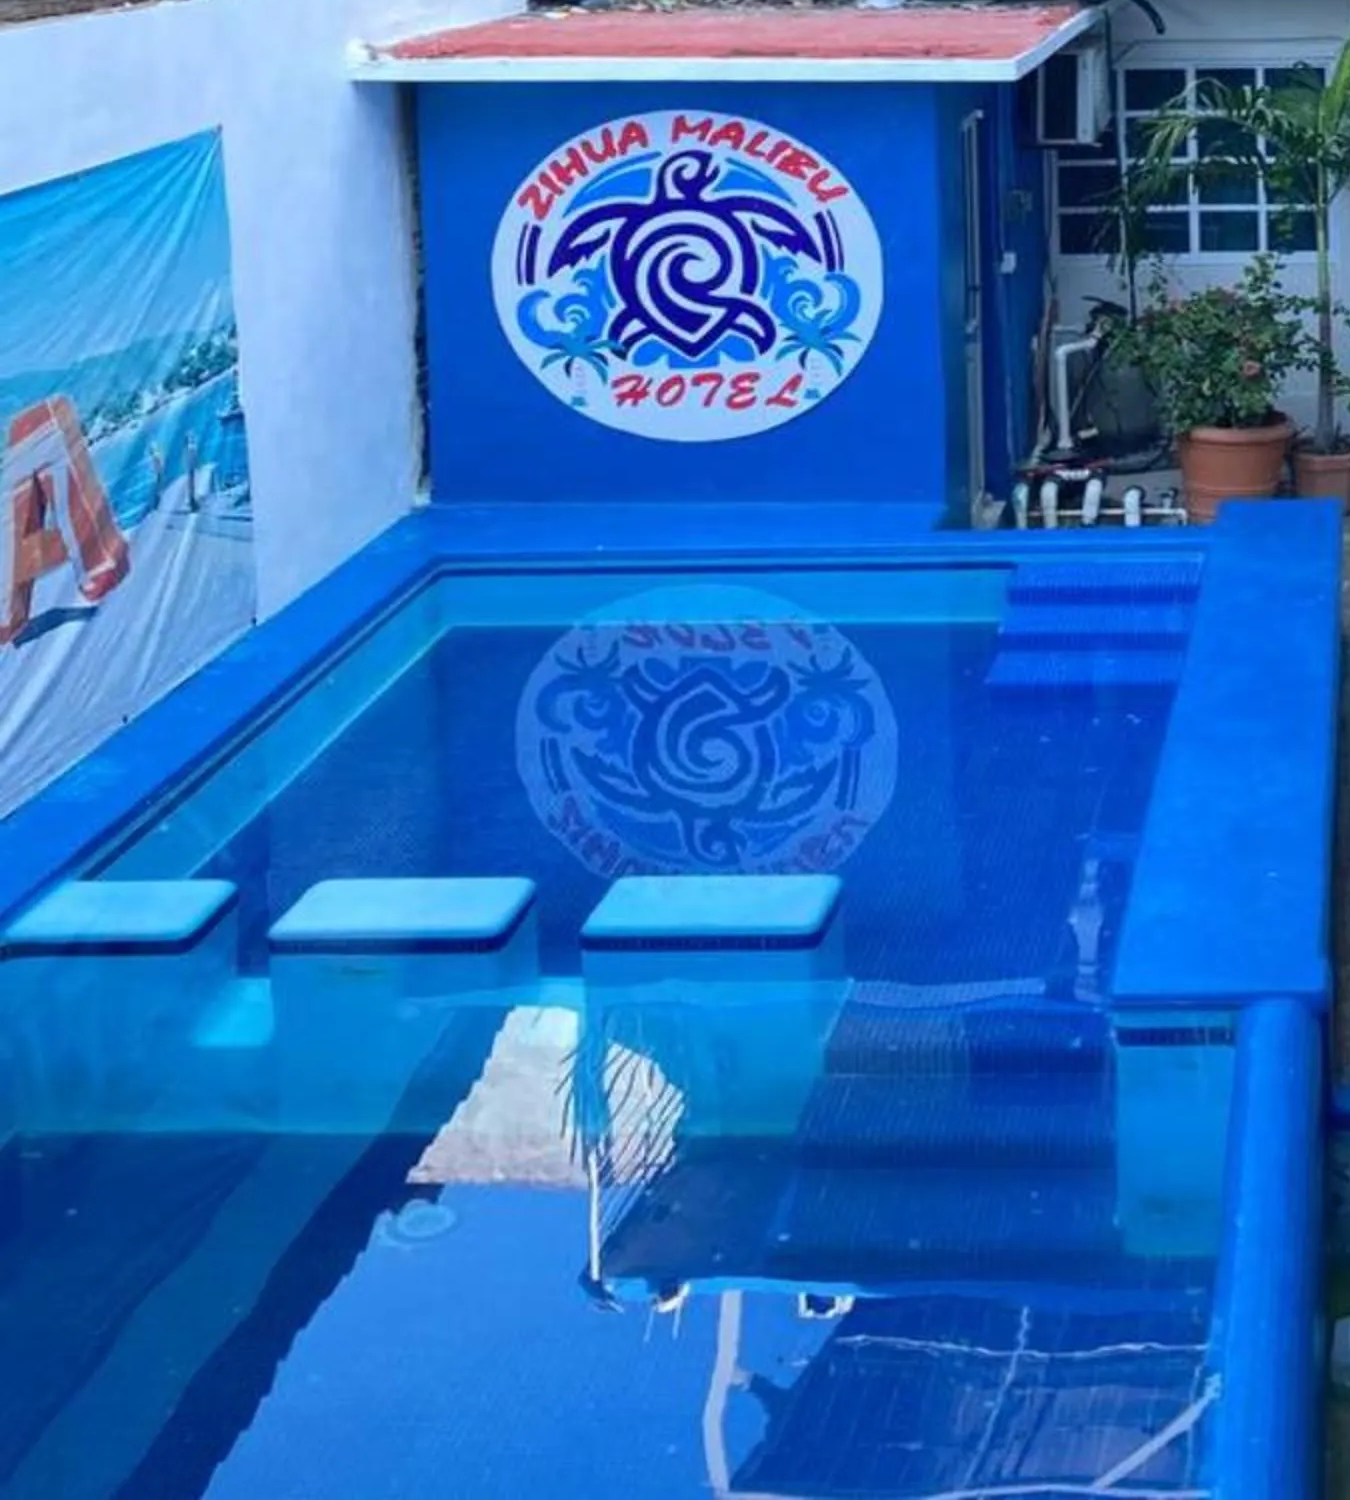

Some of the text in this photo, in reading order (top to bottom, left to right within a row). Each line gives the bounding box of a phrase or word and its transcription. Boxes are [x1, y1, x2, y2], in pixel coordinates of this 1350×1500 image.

[518, 114, 850, 221] ZIHUA MALIBU
[611, 371, 804, 410] HOTEL
